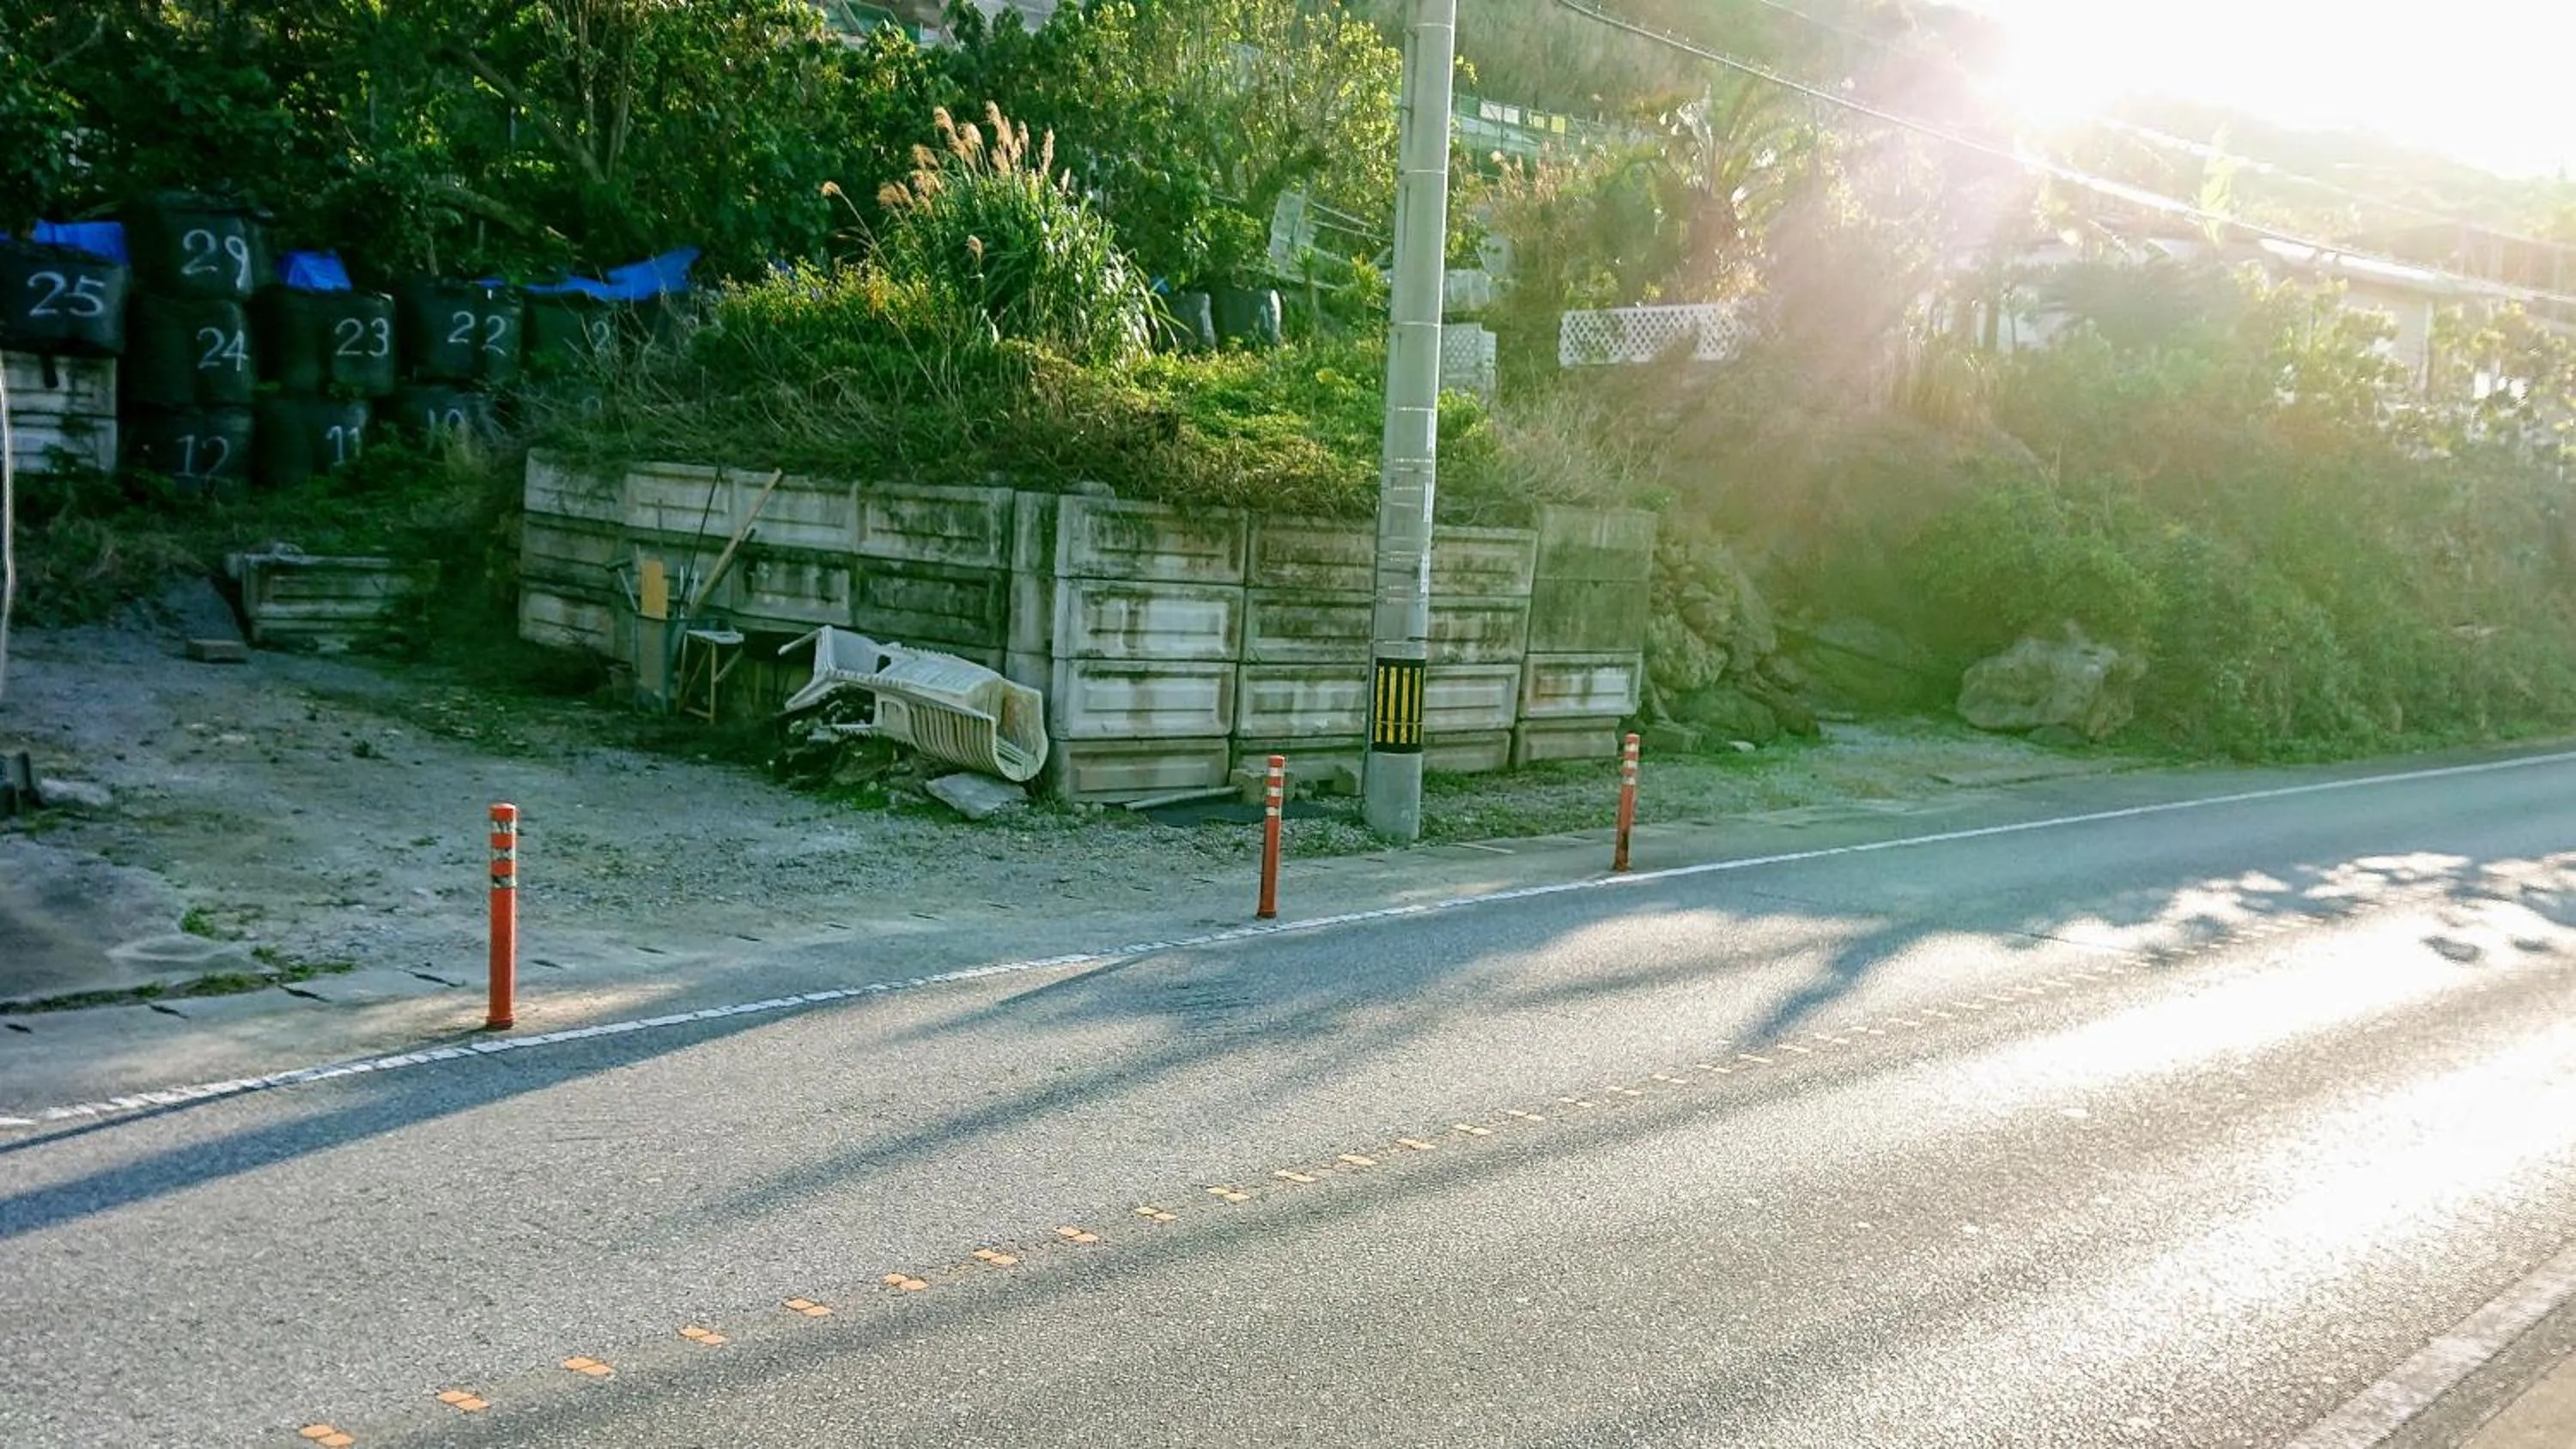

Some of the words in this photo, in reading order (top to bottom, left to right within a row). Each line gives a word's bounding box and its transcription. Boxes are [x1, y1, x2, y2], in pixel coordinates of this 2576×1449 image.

[181, 229, 252, 290] 29
[27, 270, 106, 318] 25
[196, 326, 249, 372] 24
[334, 317, 391, 357] 23
[447, 310, 507, 356] 22
[174, 434, 234, 488] 12
